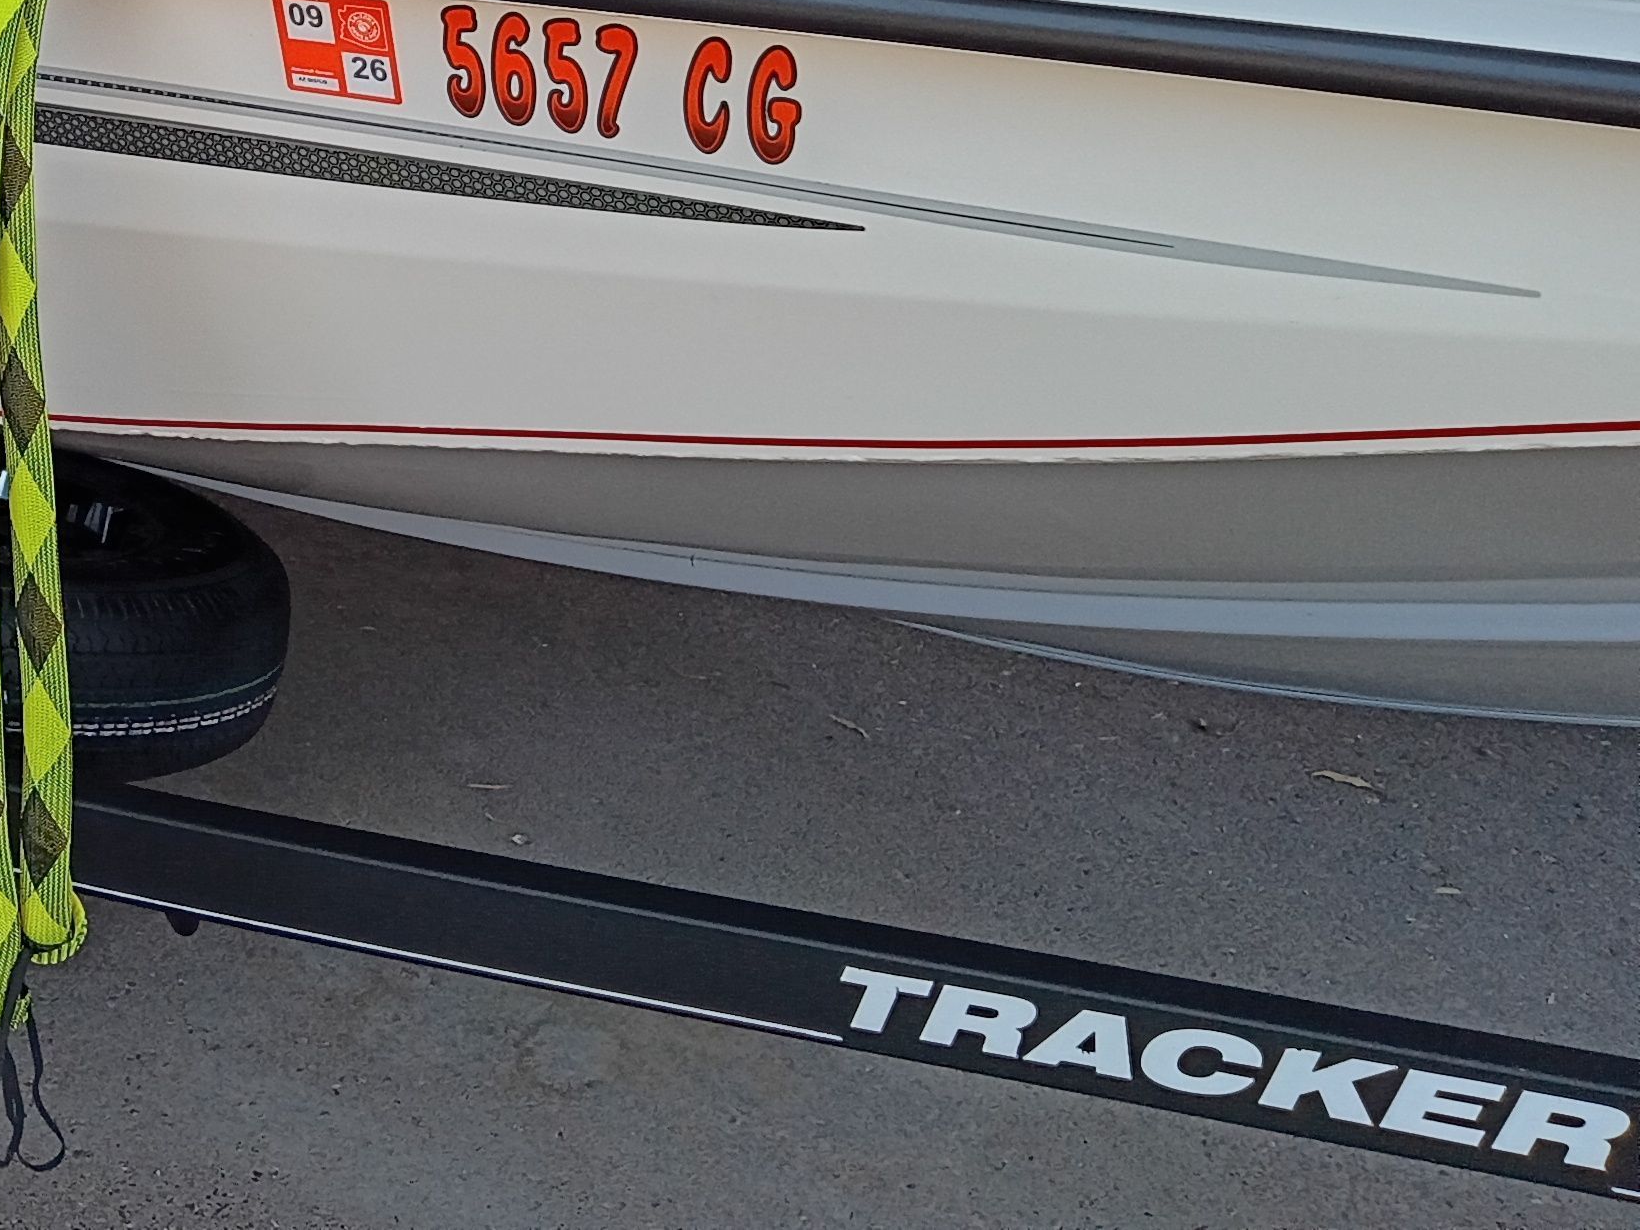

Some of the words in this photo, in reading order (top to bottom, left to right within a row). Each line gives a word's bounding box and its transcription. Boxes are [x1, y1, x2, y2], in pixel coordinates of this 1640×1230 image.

[288, 2, 323, 28] 09
[351, 56, 388, 82] 26
[441, 4, 638, 138] 5657
[683, 36, 802, 165] CG
[839, 965, 1631, 1172] TRACKER
